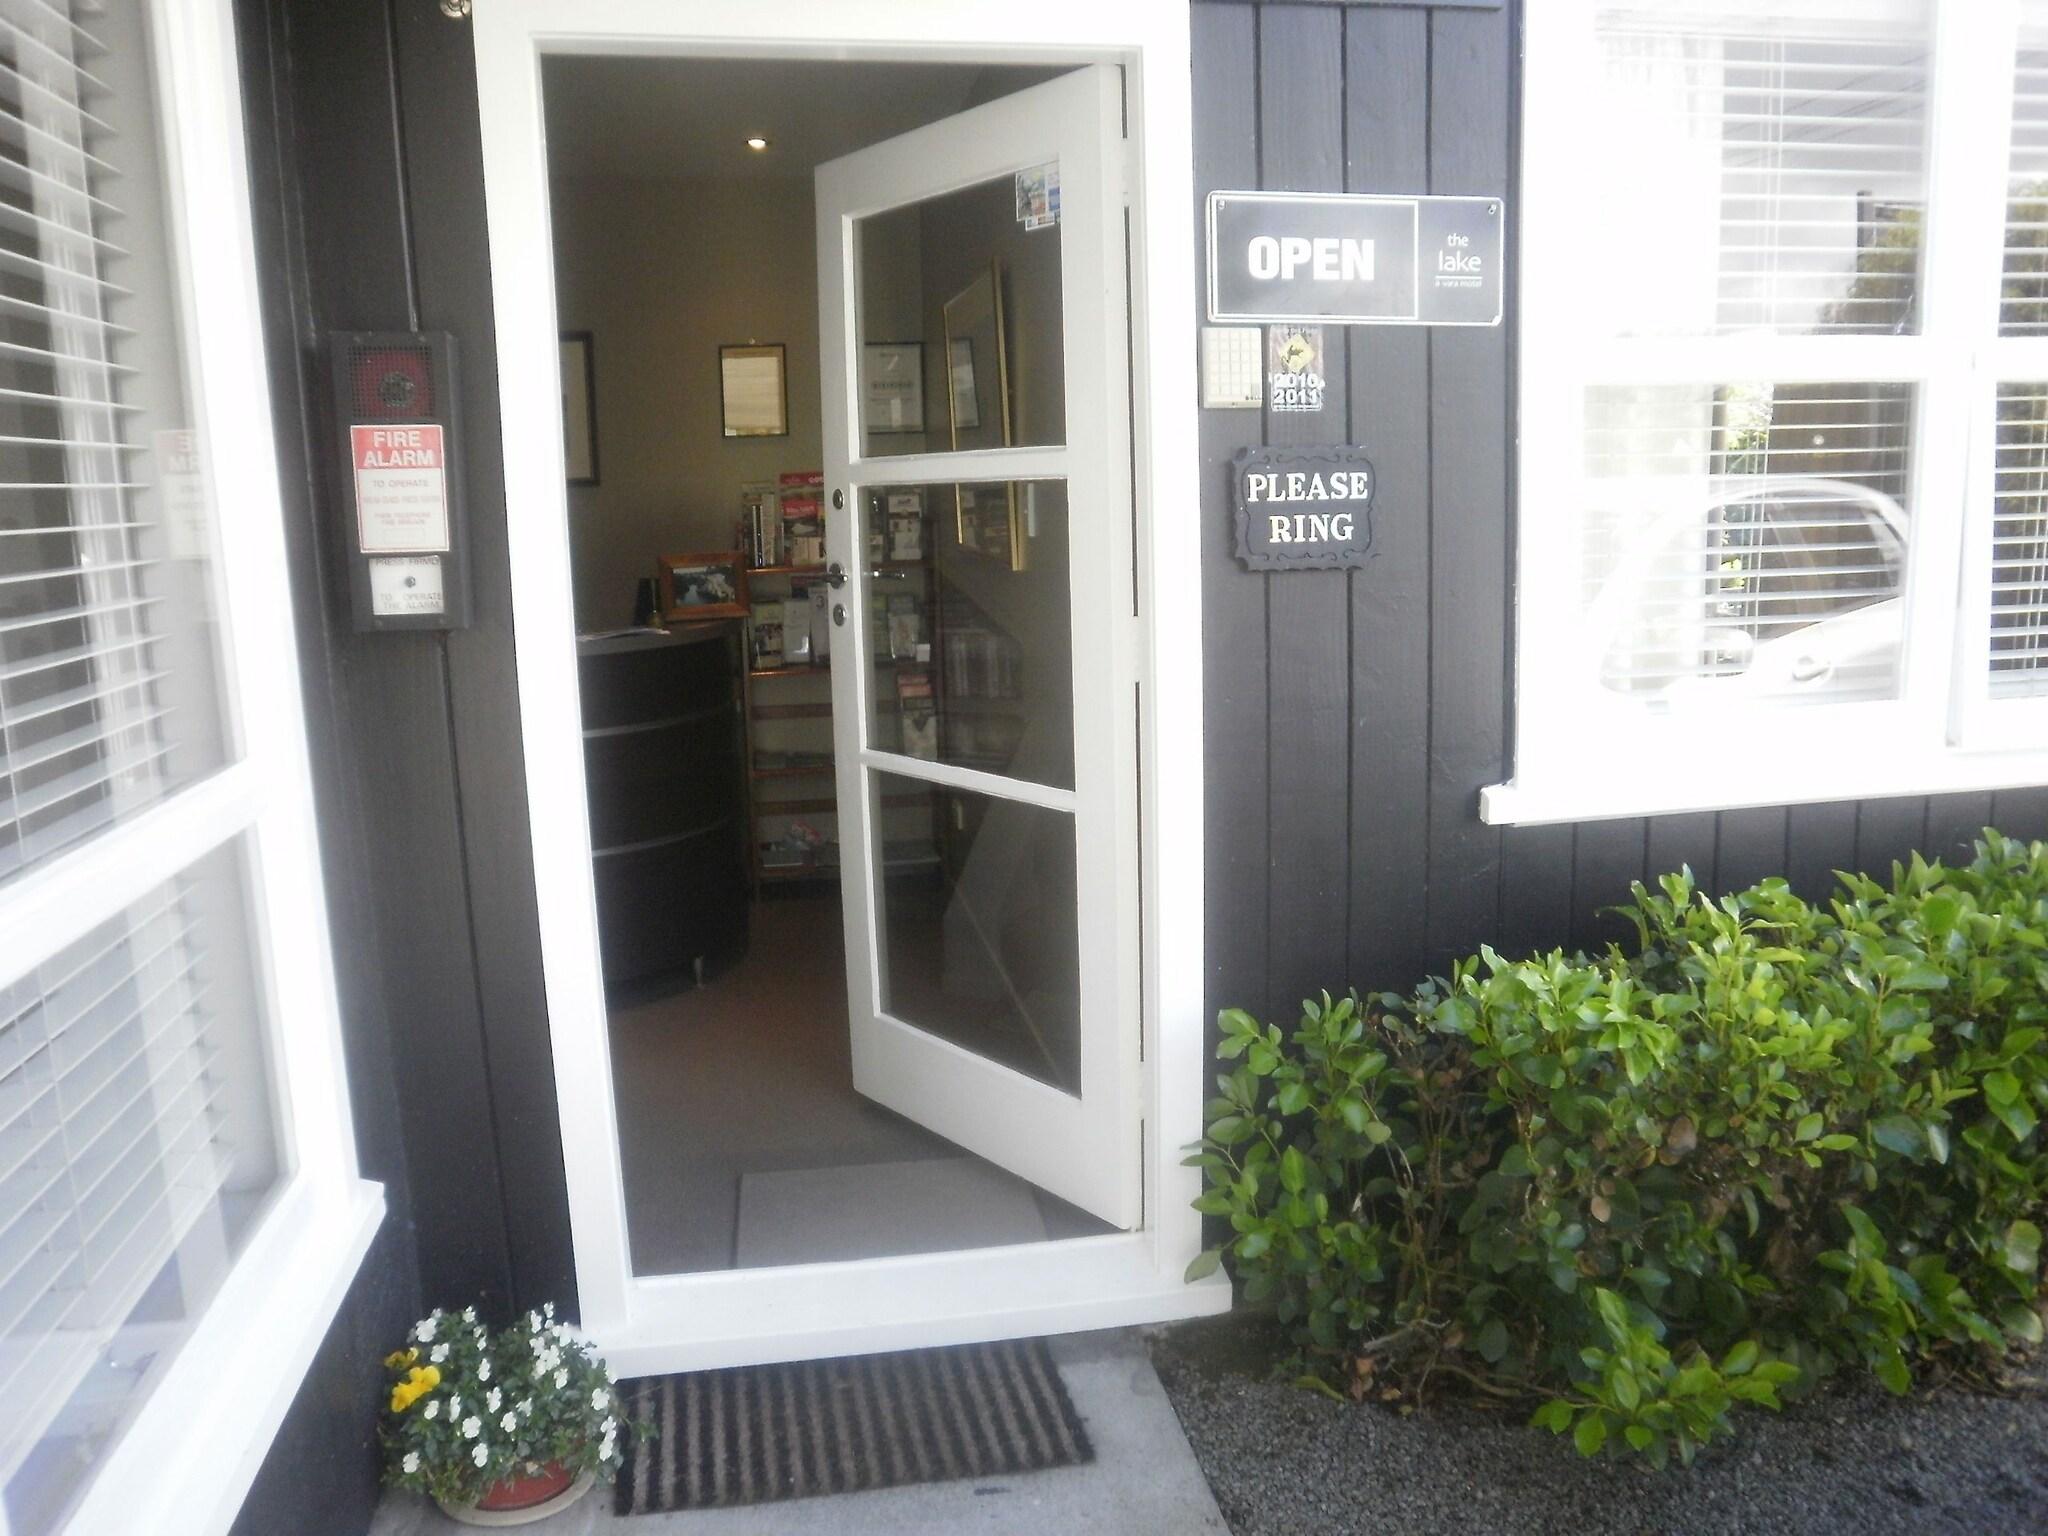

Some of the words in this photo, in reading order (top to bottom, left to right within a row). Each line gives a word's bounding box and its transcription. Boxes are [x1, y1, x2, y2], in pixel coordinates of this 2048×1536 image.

[1447, 233, 1469, 247] the
[1248, 236, 1375, 280] OPEN
[1438, 250, 1481, 272] lake
[373, 431, 421, 447] FIRE
[363, 450, 433, 466] ALARM
[1248, 472, 1368, 502] PLEASE
[1269, 513, 1354, 543] RING
